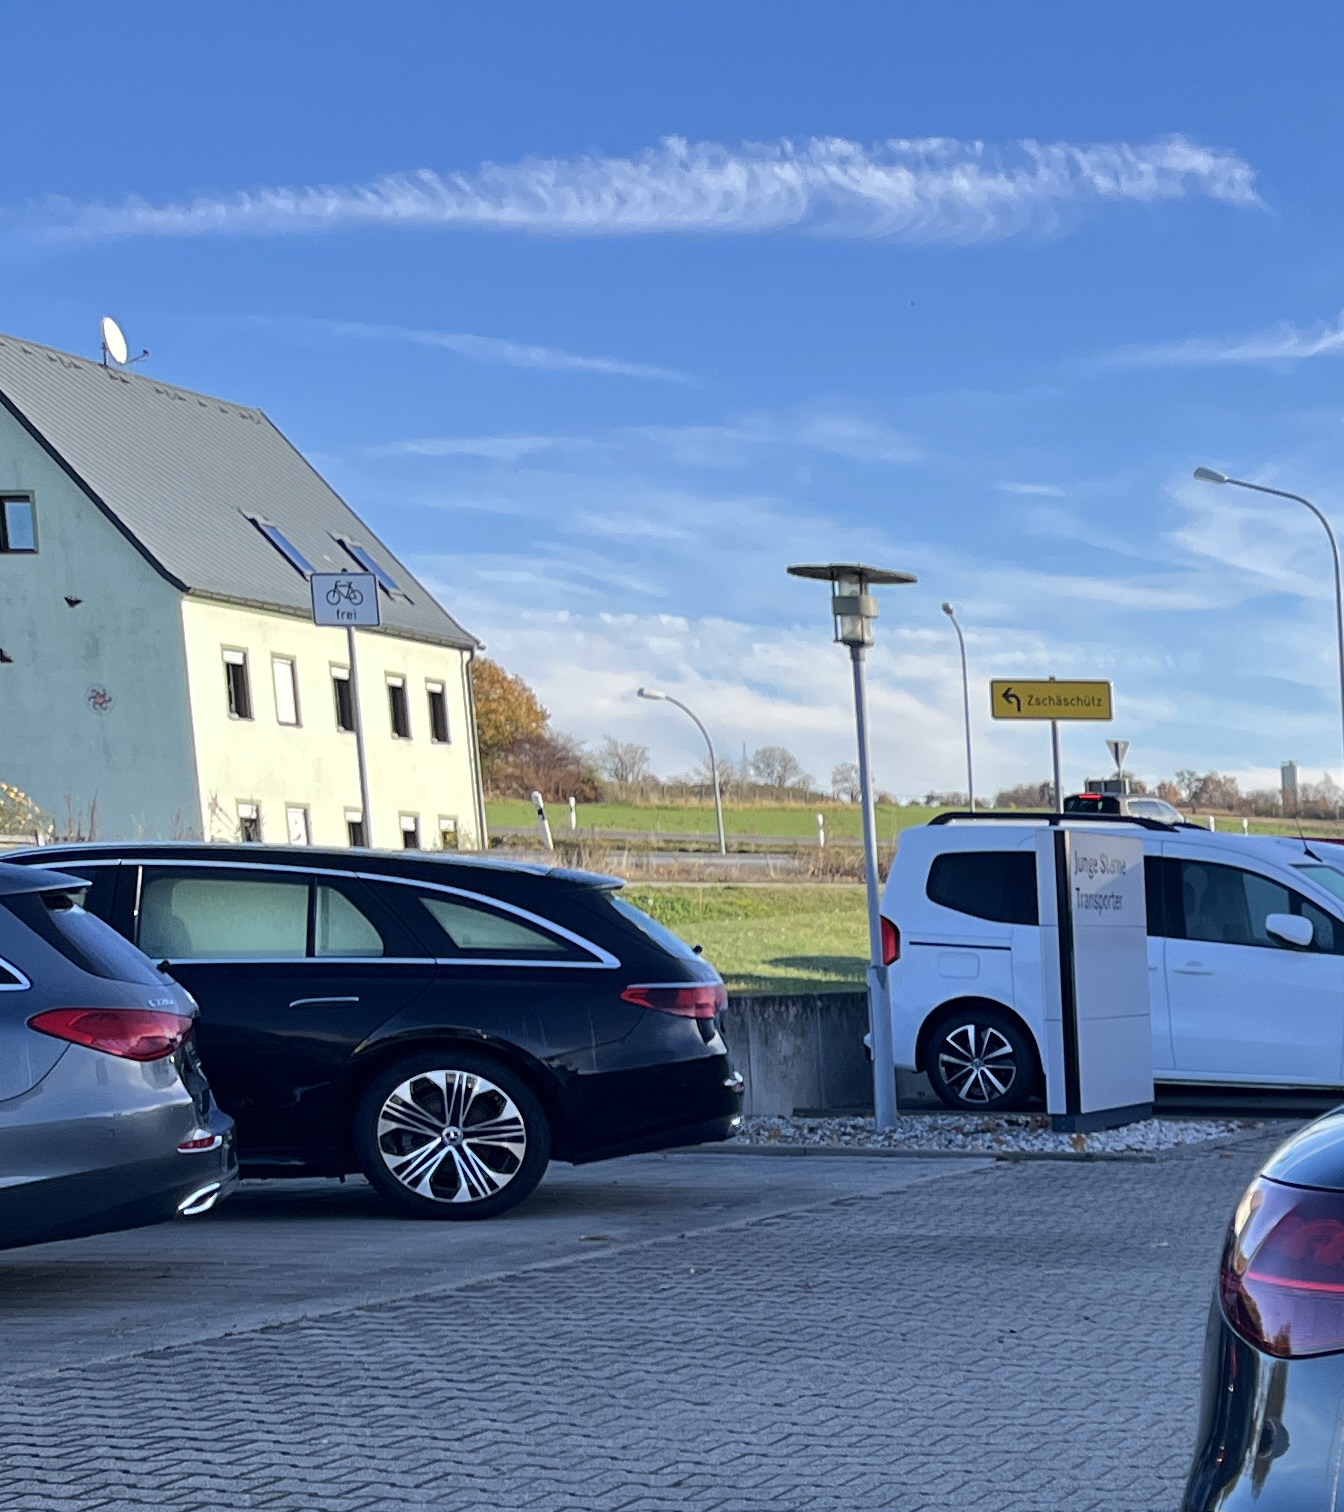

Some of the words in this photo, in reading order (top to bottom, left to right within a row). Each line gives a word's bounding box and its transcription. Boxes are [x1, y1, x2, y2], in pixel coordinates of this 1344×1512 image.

[336, 608, 357, 620] frei
[1027, 694, 1103, 707] Zschäschütz
[1074, 849, 1098, 880] Junge
[1075, 887, 1123, 916] Transporter
